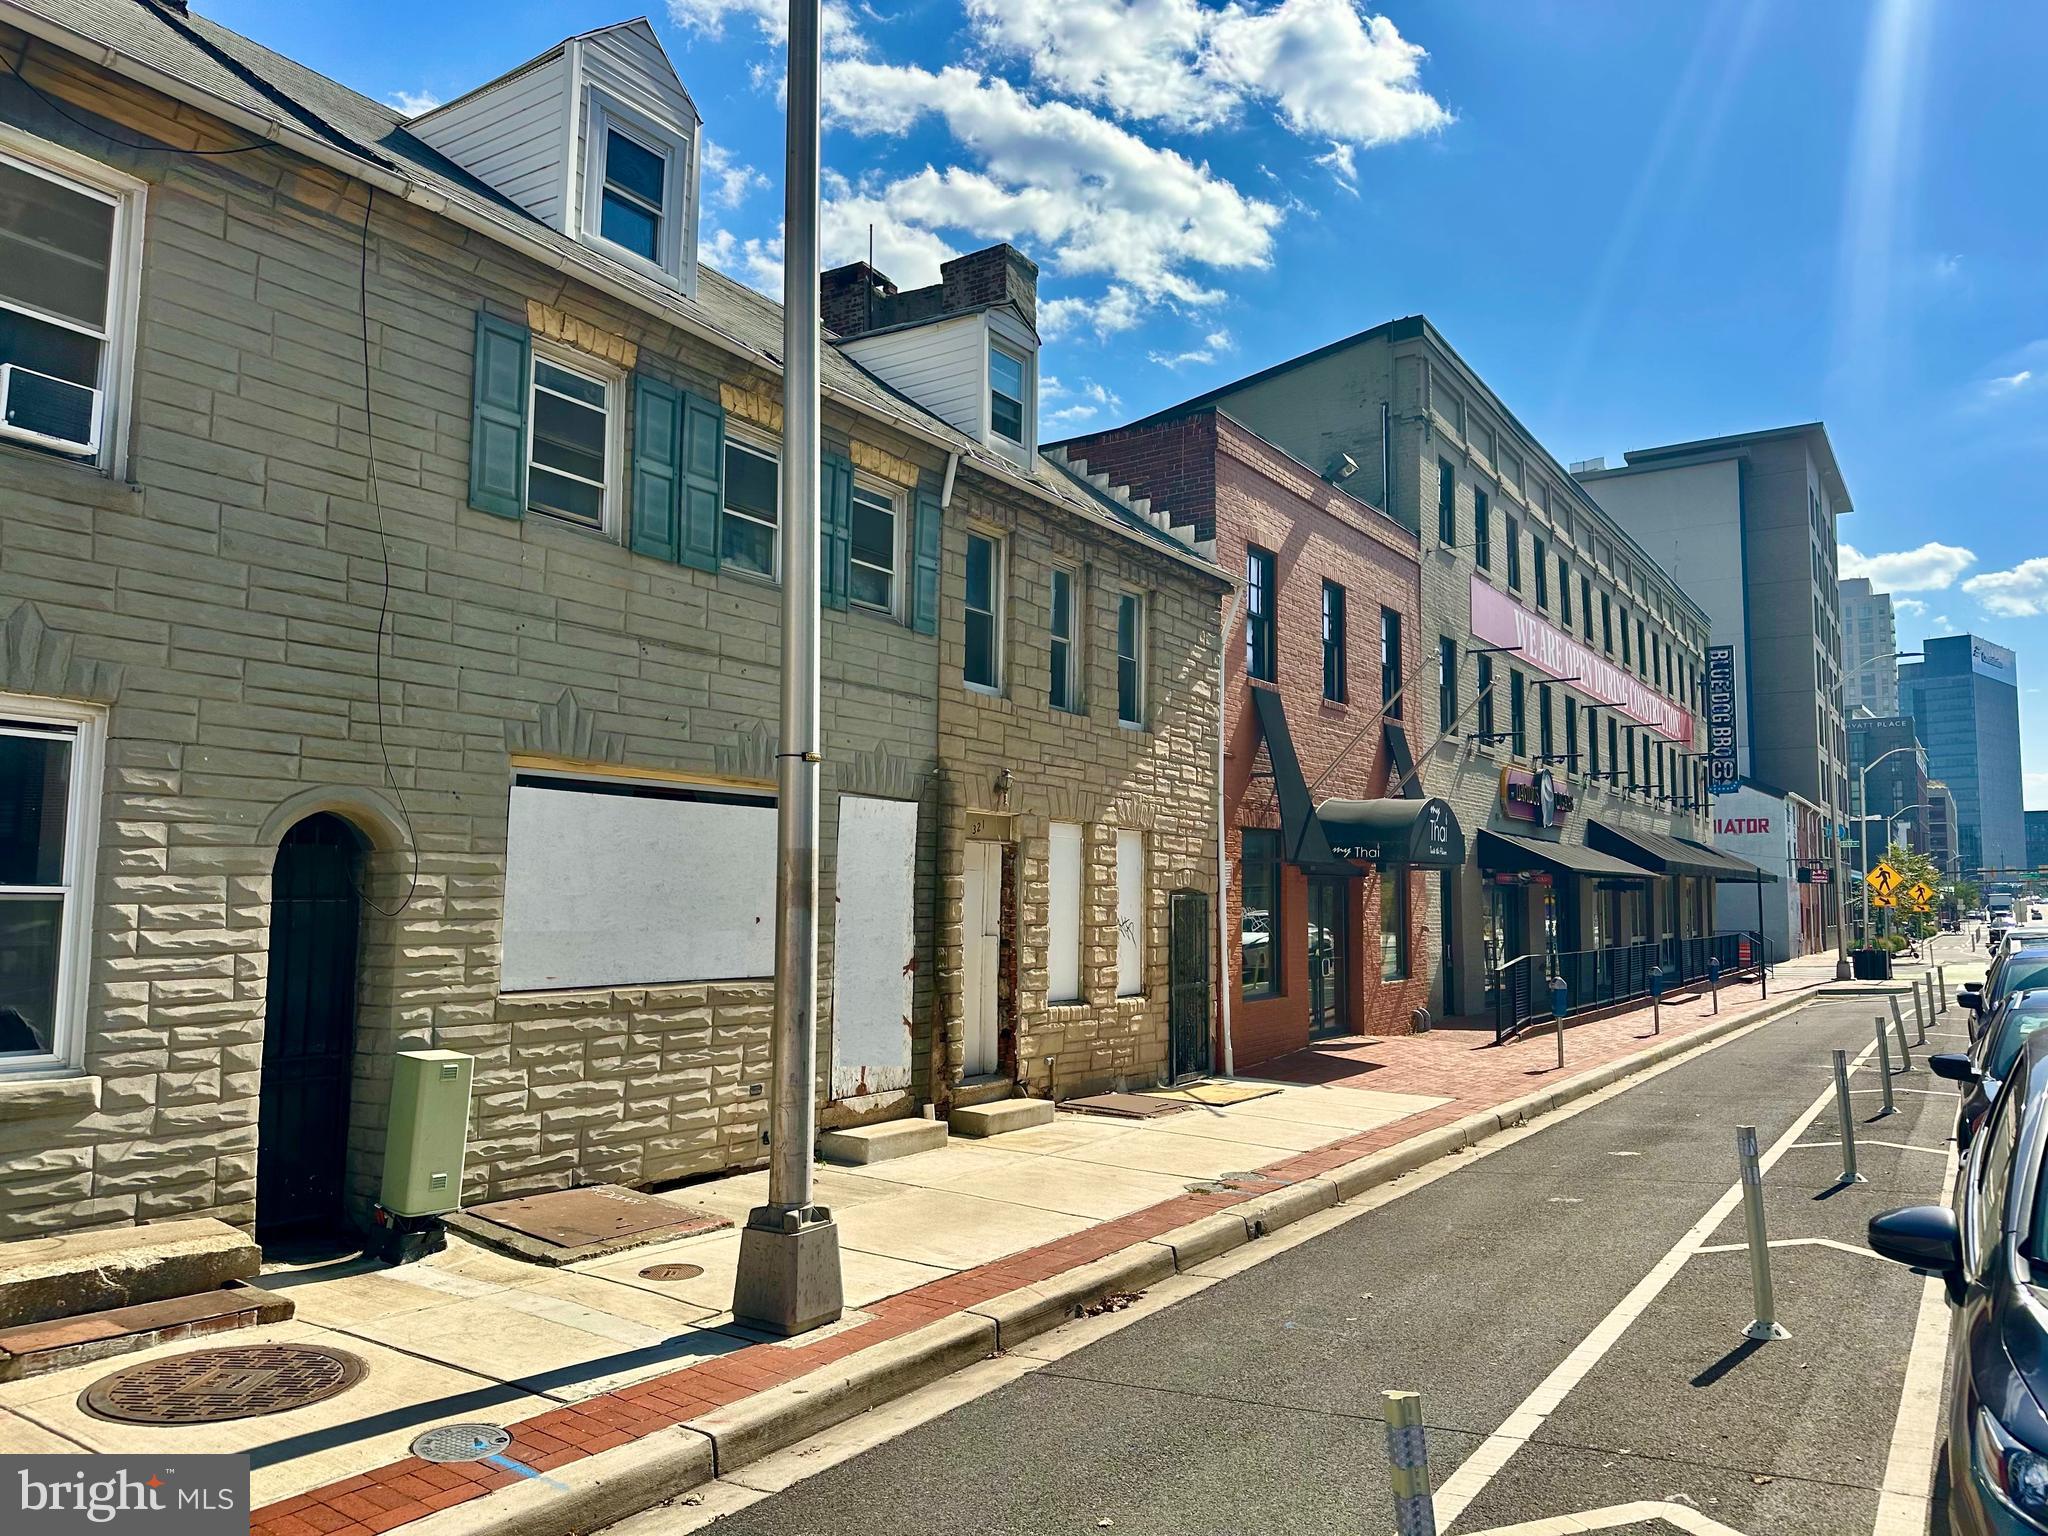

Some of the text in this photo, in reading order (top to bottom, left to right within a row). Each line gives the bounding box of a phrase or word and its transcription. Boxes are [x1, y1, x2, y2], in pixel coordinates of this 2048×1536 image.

[1513, 608, 1537, 659] WE
[1540, 626, 1563, 673] ARE
[1565, 642, 1593, 690] OPEN
[1594, 659, 1628, 709] DURING
[1710, 650, 1732, 756] BLUE DOG BBQ
[1877, 720, 1907, 728] PLACE
[1711, 761, 1734, 779] CO
[1430, 805, 1441, 821] my
[972, 819, 985, 835] 321
[1429, 812, 1448, 842] Thai
[1713, 818, 1770, 834] IATOR
[1332, 842, 1380, 858] my Thai
